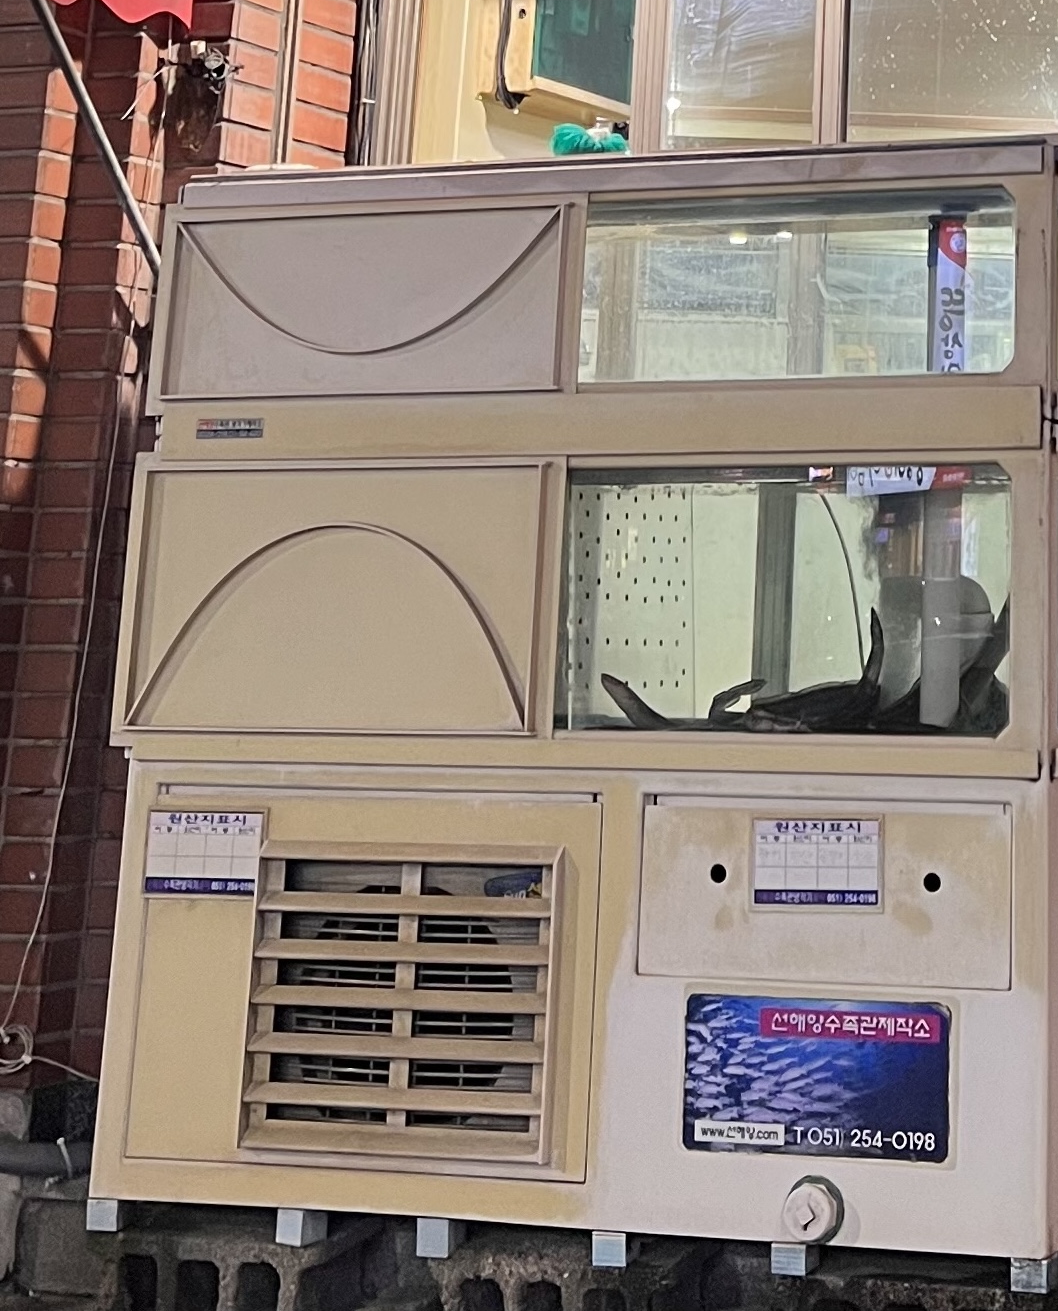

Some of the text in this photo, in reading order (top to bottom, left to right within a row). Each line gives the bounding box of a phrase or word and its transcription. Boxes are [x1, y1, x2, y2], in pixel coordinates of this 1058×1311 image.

[168, 813, 247, 826] 원산지표시
[775, 821, 861, 834] 원산지표시
[771, 1012, 931, 1038] 선해양수족관제작소
[850, 1129, 936, 1152] 254-0198
